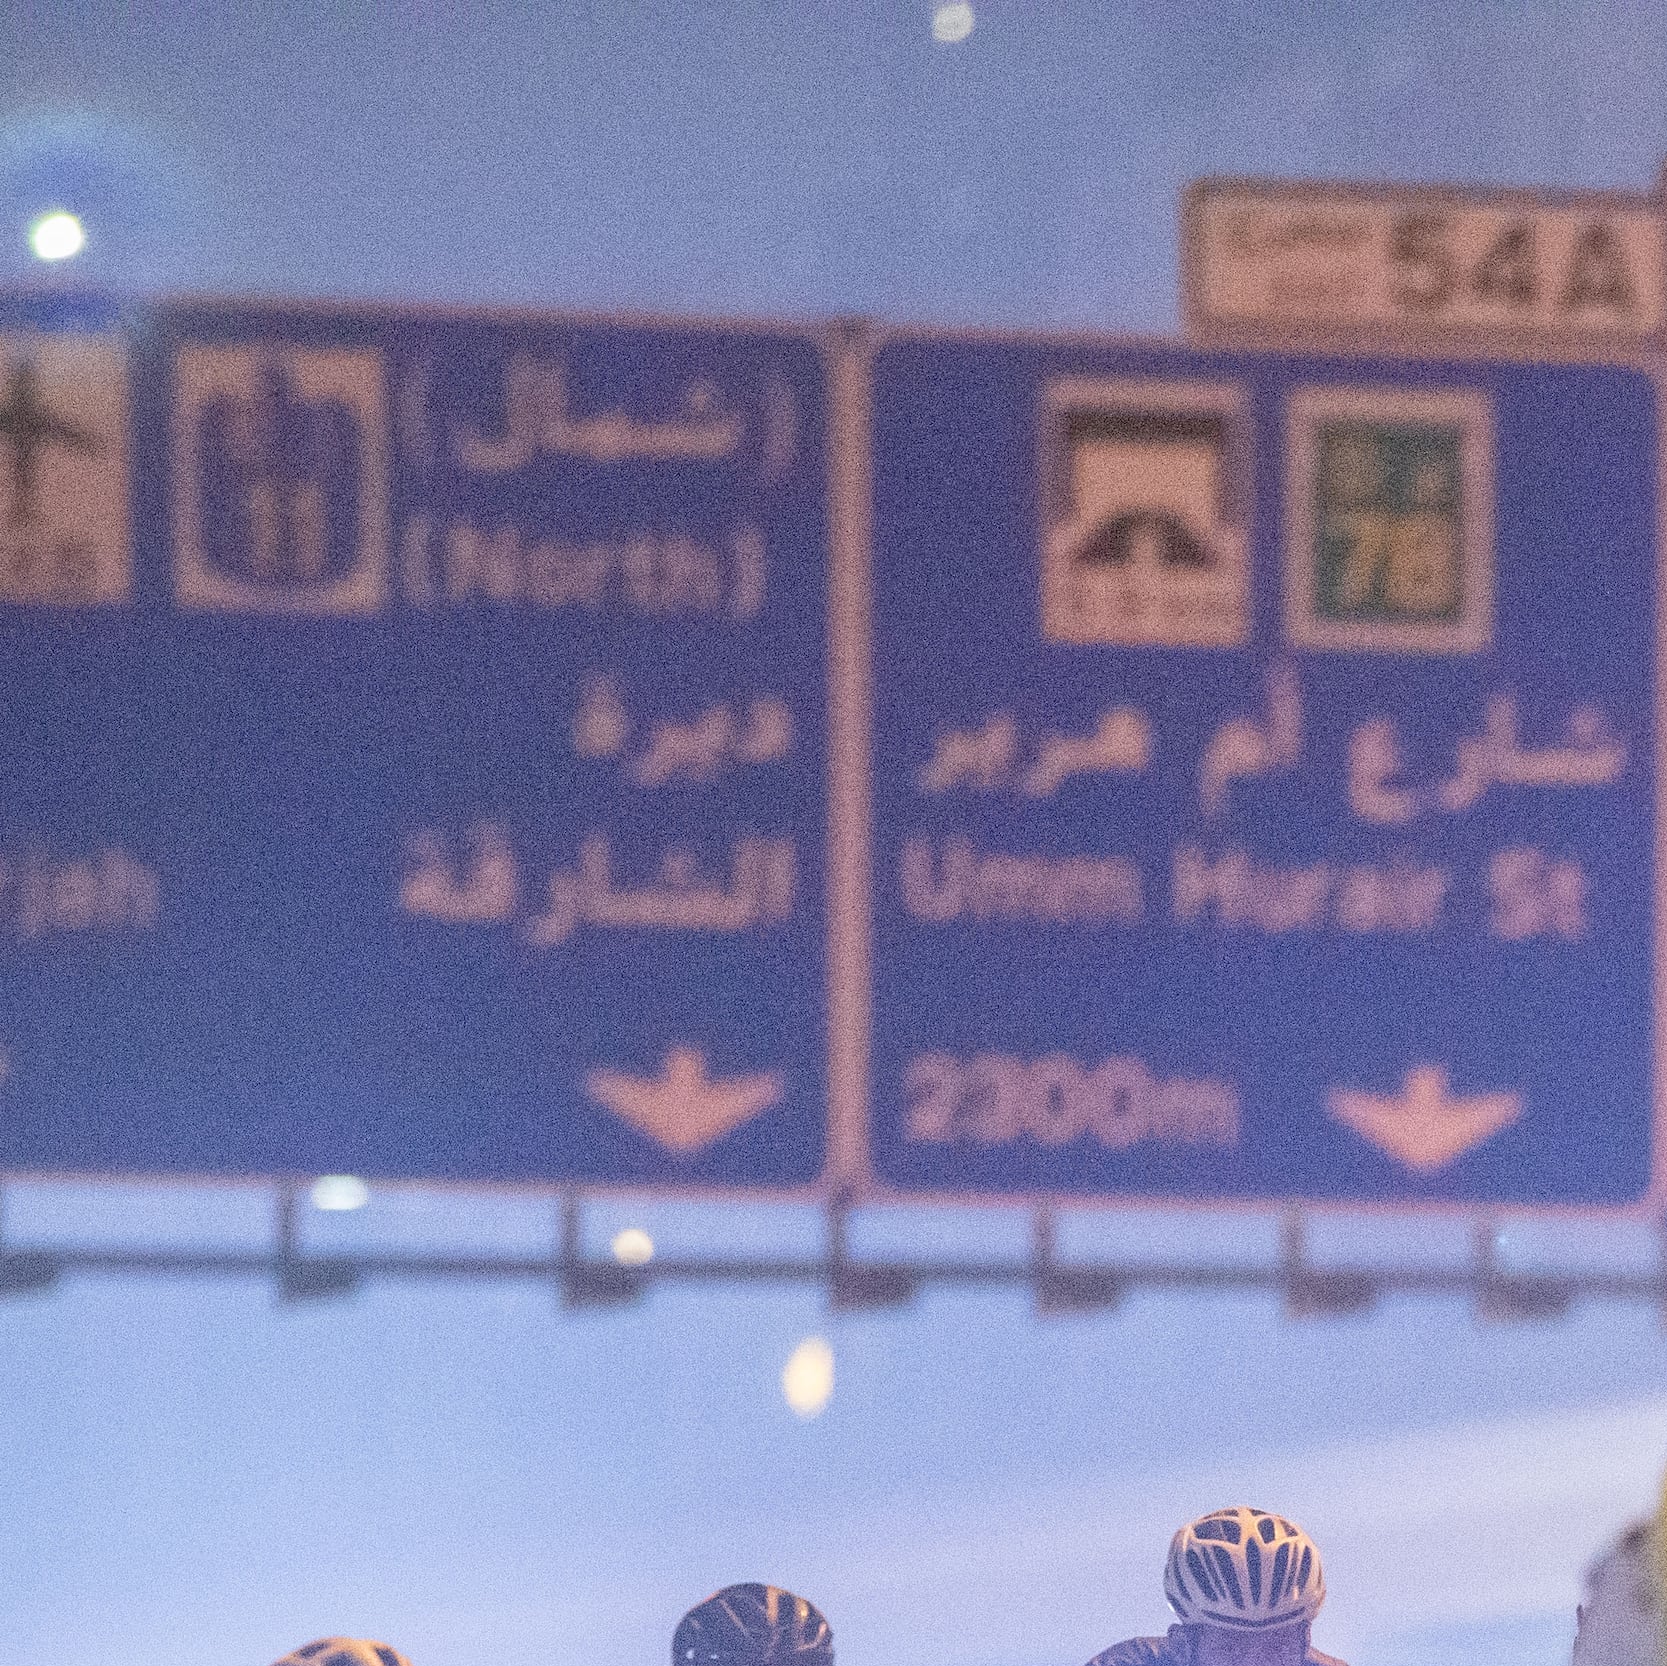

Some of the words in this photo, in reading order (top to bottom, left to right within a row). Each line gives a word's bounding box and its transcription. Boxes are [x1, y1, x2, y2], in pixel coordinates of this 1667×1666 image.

[1388, 216, 1638, 314] 54A
[1347, 690, 1626, 822] شارع
[0, 838, 162, 940] jah
[900, 838, 1144, 925] Umm
[1488, 848, 1590, 942] St
[902, 1052, 1242, 1150] 2300m
